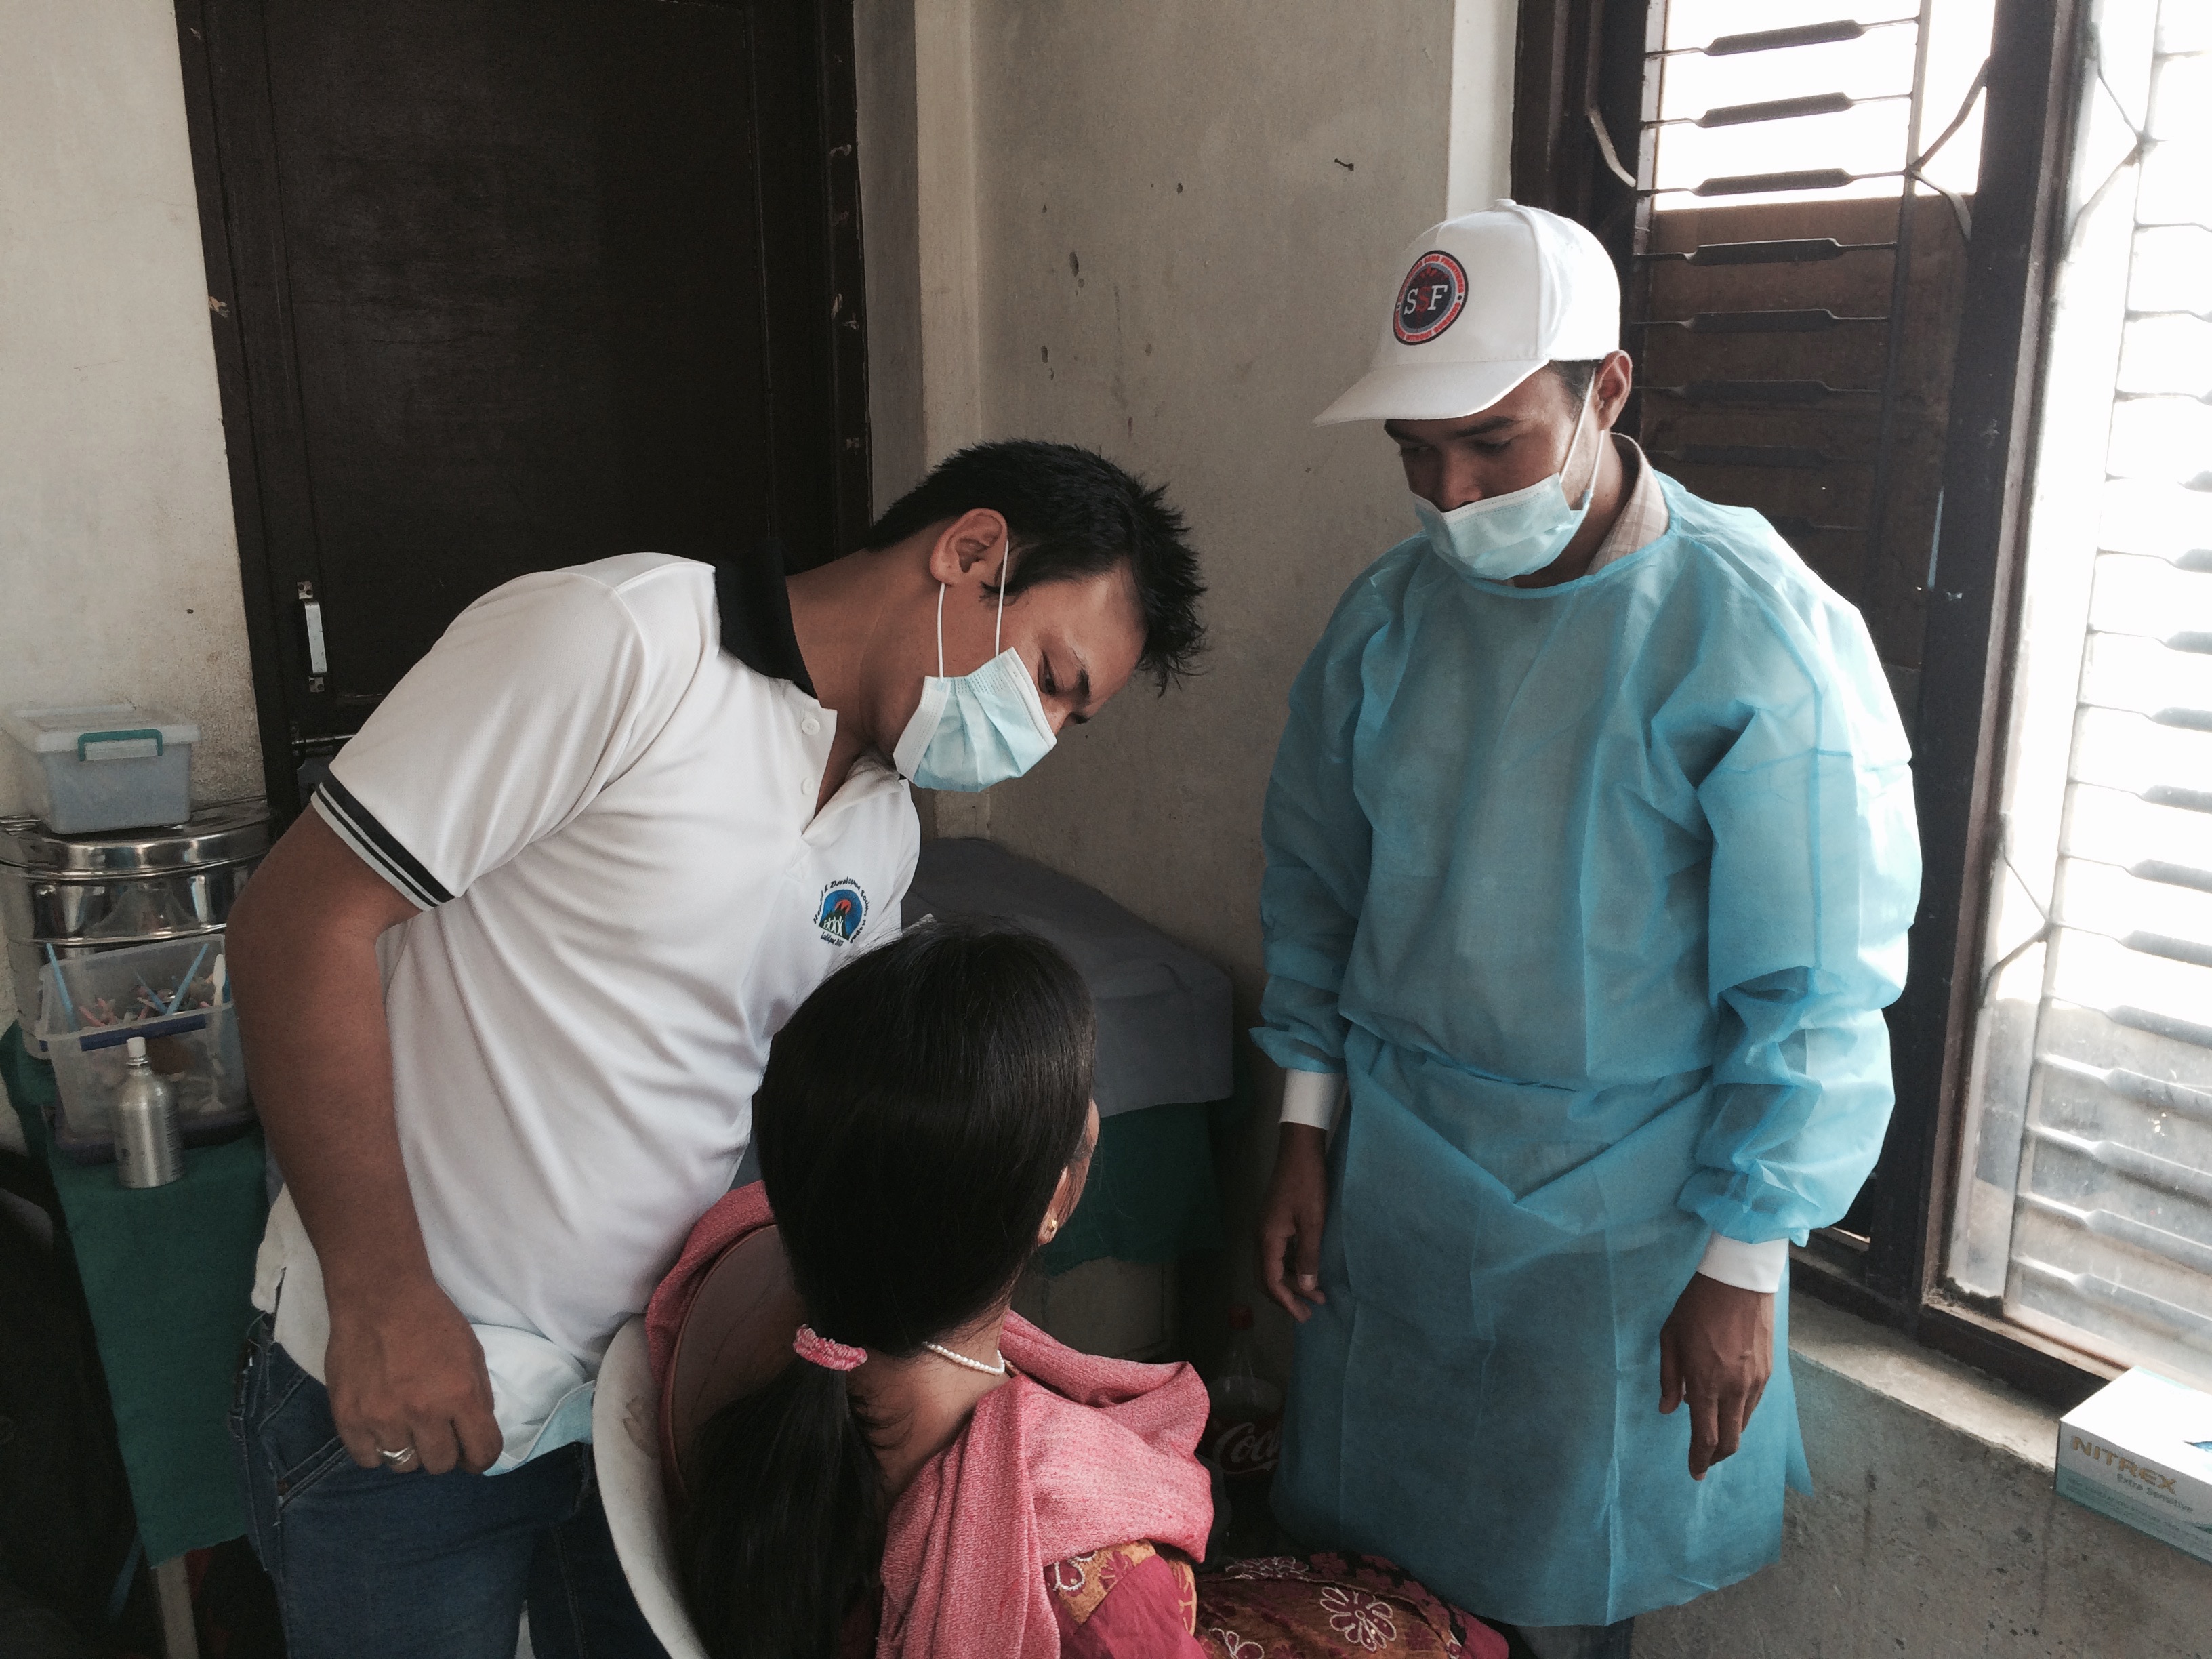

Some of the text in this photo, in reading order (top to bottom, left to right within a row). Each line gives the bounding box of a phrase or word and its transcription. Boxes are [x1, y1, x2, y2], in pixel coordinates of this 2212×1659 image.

[2072, 1436, 2177, 1495] NITREX
[2116, 1473, 2194, 1513] Extra Sensitive
